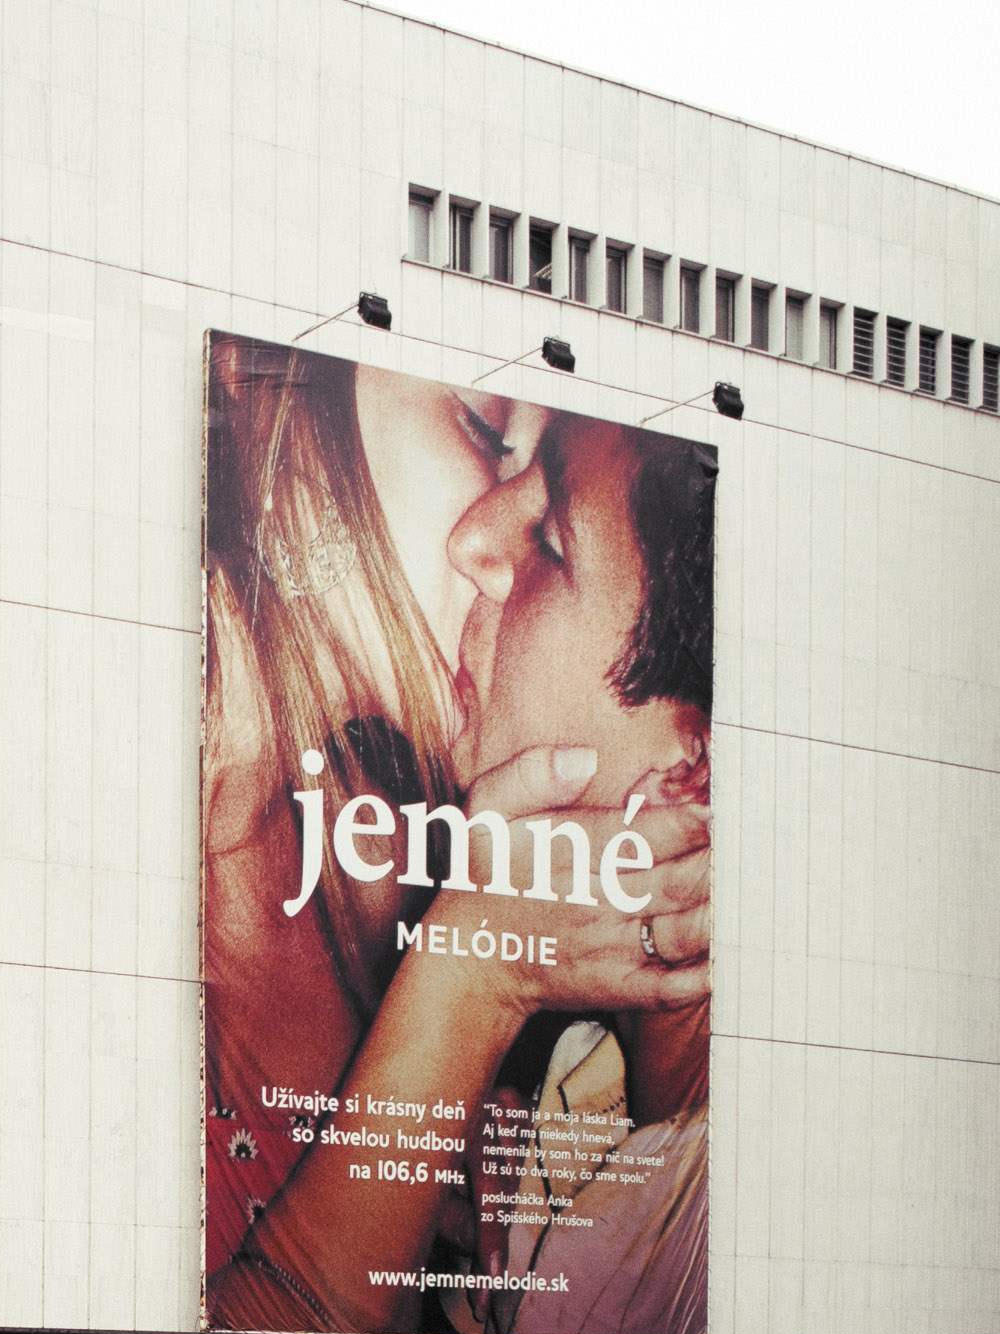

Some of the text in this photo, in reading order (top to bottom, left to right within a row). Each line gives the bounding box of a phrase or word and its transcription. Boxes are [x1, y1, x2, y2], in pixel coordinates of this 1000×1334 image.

[283, 749, 653, 918] jemné
[397, 919, 558, 966] MELÓDIE
[262, 1086, 465, 1123] Užívajte si krásny deň
[506, 1109, 528, 1119] som
[532, 1108, 541, 1122] ja
[544, 1112, 550, 1120] a
[554, 1112, 579, 1125] moja
[583, 1112, 607, 1125] láska
[611, 1114, 635, 1127] Liam.
[292, 1124, 465, 1152] so skvelou hudbou
[483, 1123, 614, 1145] Aj keď ma niekedy hnevá,
[483, 1145, 664, 1166] nemenila by som ho za nič na svete!
[350, 1164, 370, 1179] na
[435, 1169, 465, 1184] MHz
[482, 1162, 497, 1174] Už
[501, 1162, 512, 1174] sú
[516, 1166, 527, 1176] to
[531, 1166, 548, 1177] dva
[552, 1168, 577, 1181] roky,
[580, 1167, 592, 1180] čo
[596, 1172, 616, 1181] sme
[482, 1192, 573, 1207] poslucháčka Anka
[481, 1211, 593, 1227] zo Spišského Hrušova
[368, 1267, 569, 1292] www.jemnemelodie.sk
